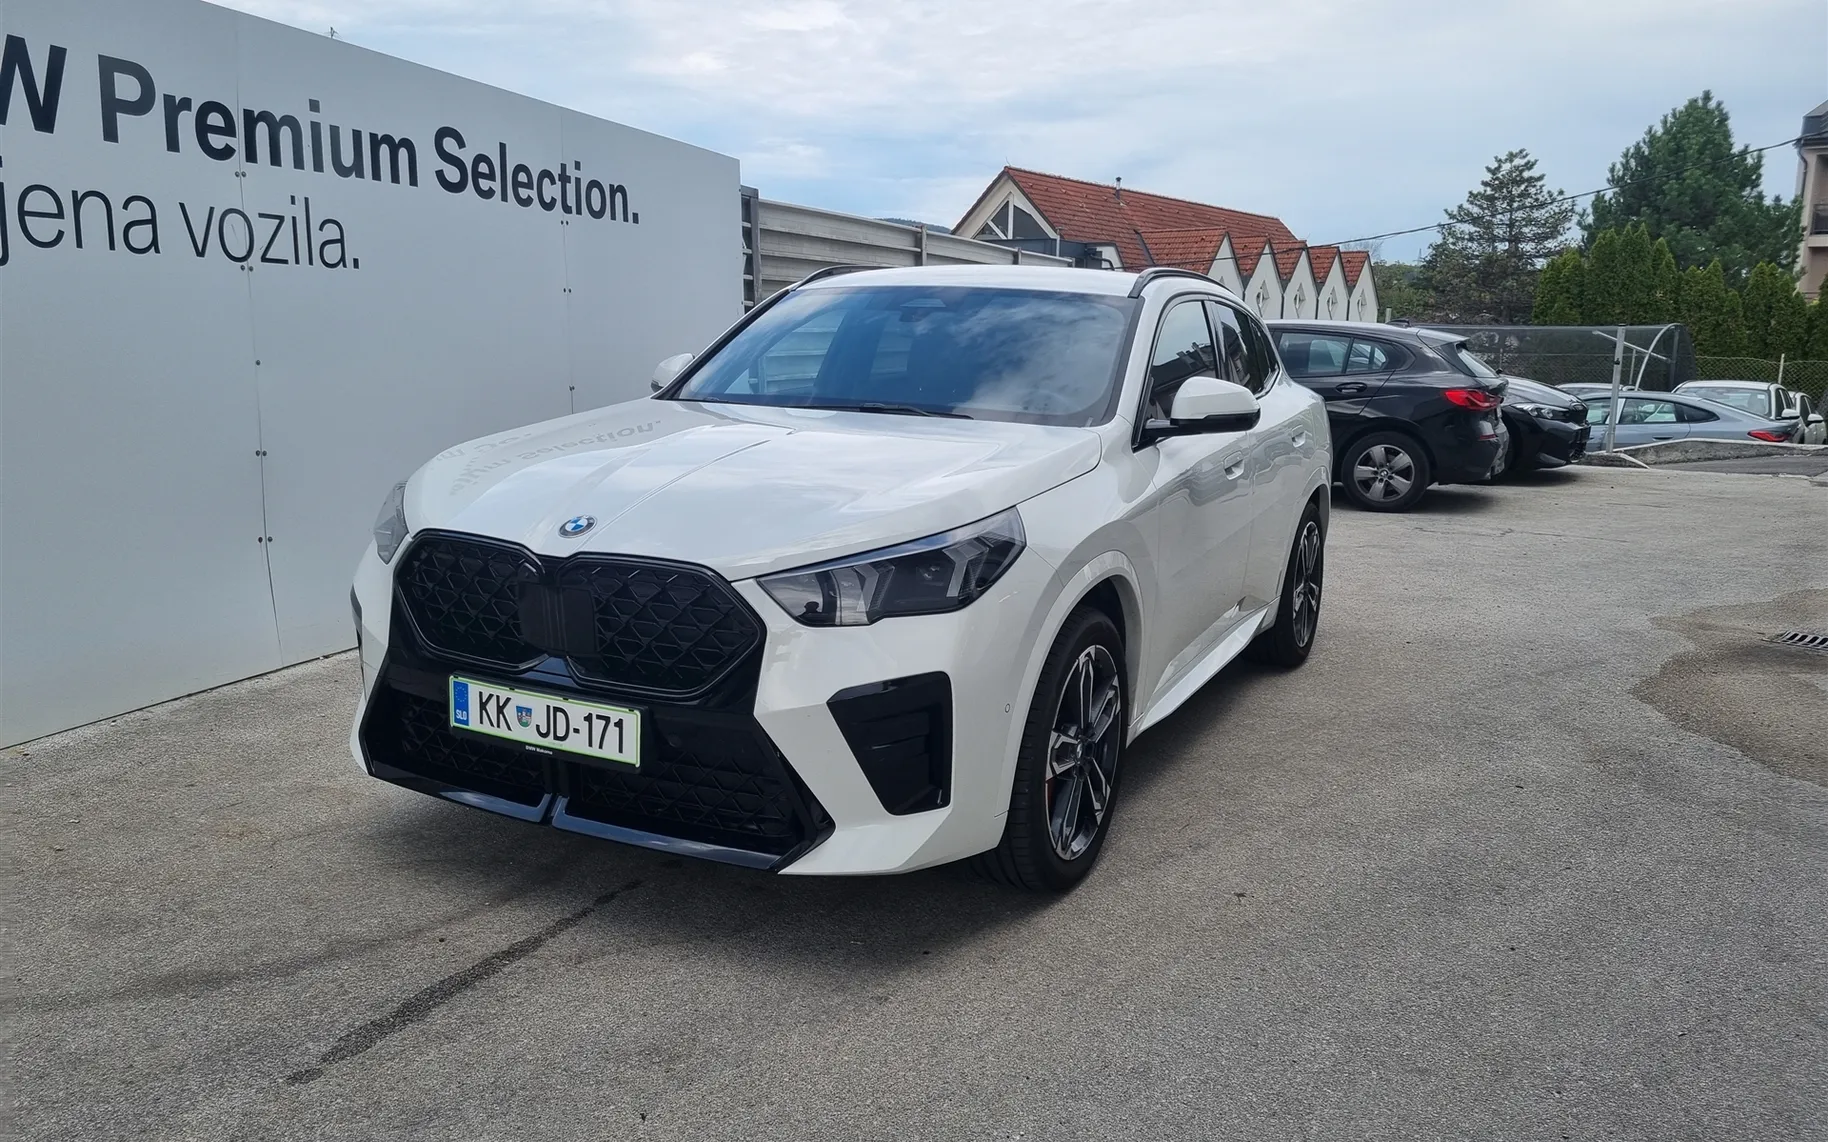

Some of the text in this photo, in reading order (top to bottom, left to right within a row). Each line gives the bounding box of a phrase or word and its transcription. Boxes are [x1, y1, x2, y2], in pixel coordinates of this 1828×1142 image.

[98, 53, 419, 188] Premium
[434, 126, 640, 225] Selection.
[178, 196, 361, 270] vozila.
[478, 691, 624, 754] KK JD-171
